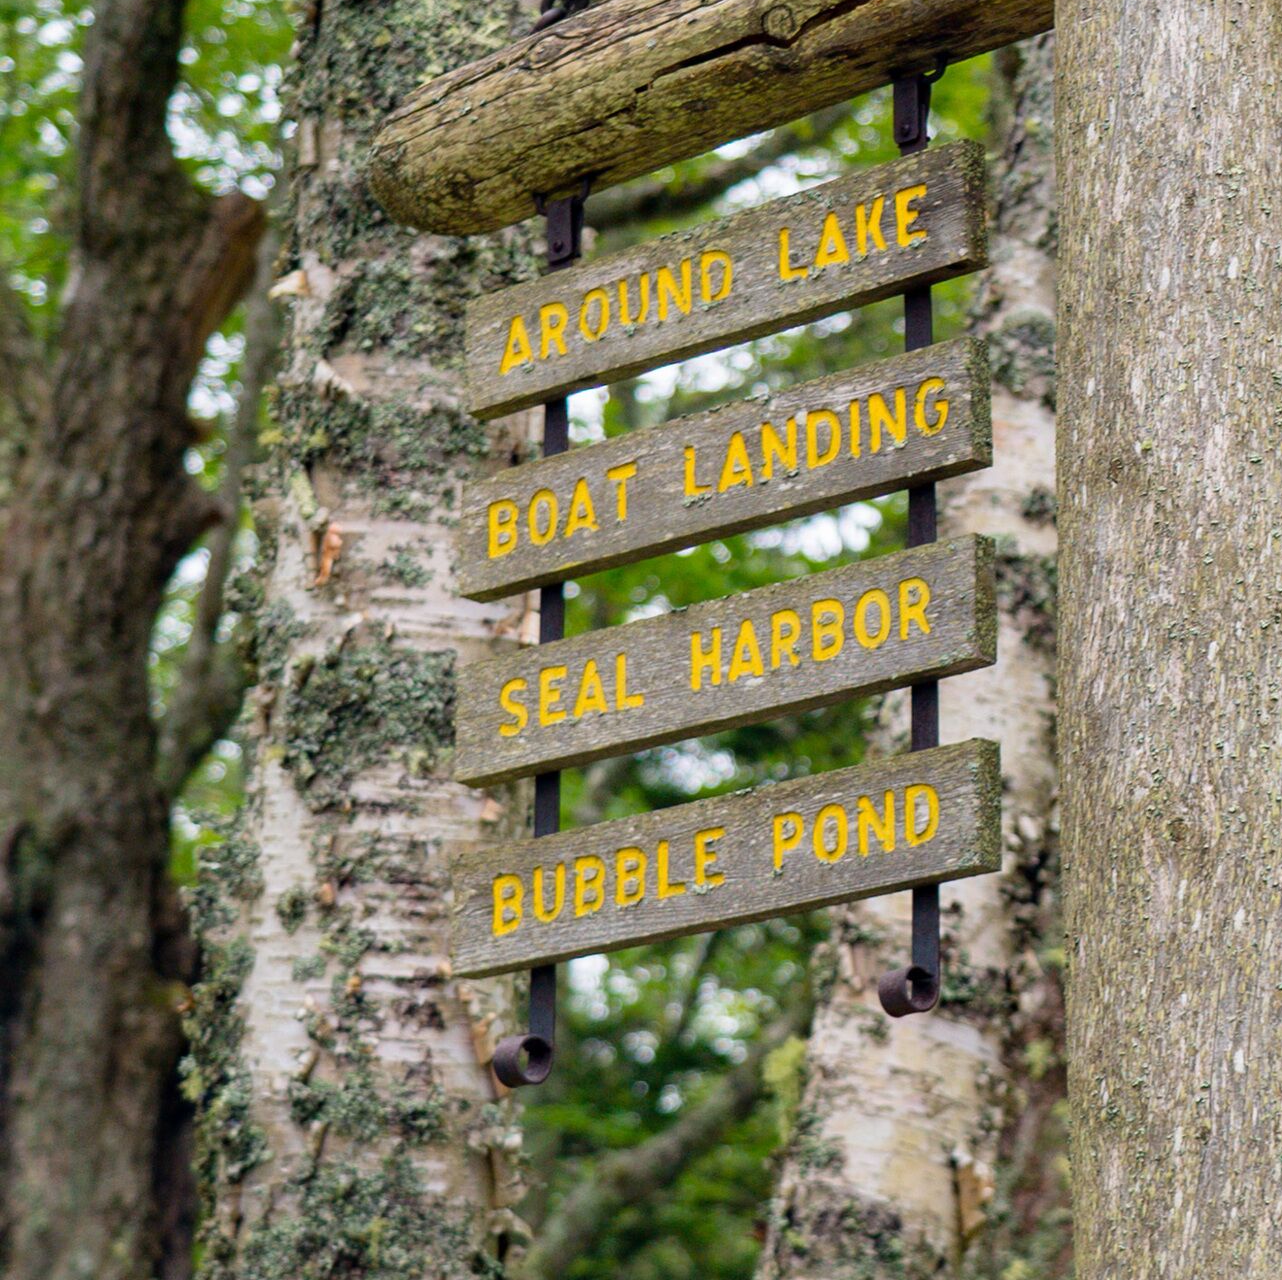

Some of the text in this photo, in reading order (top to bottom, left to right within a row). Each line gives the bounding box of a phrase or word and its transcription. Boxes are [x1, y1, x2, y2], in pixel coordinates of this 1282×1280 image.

[498, 184, 928, 374] AROUND LAKE
[486, 377, 950, 558] BOAT LANDING
[497, 577, 931, 736] SEAL HARBOR
[491, 783, 940, 936] BUBBLE POND
